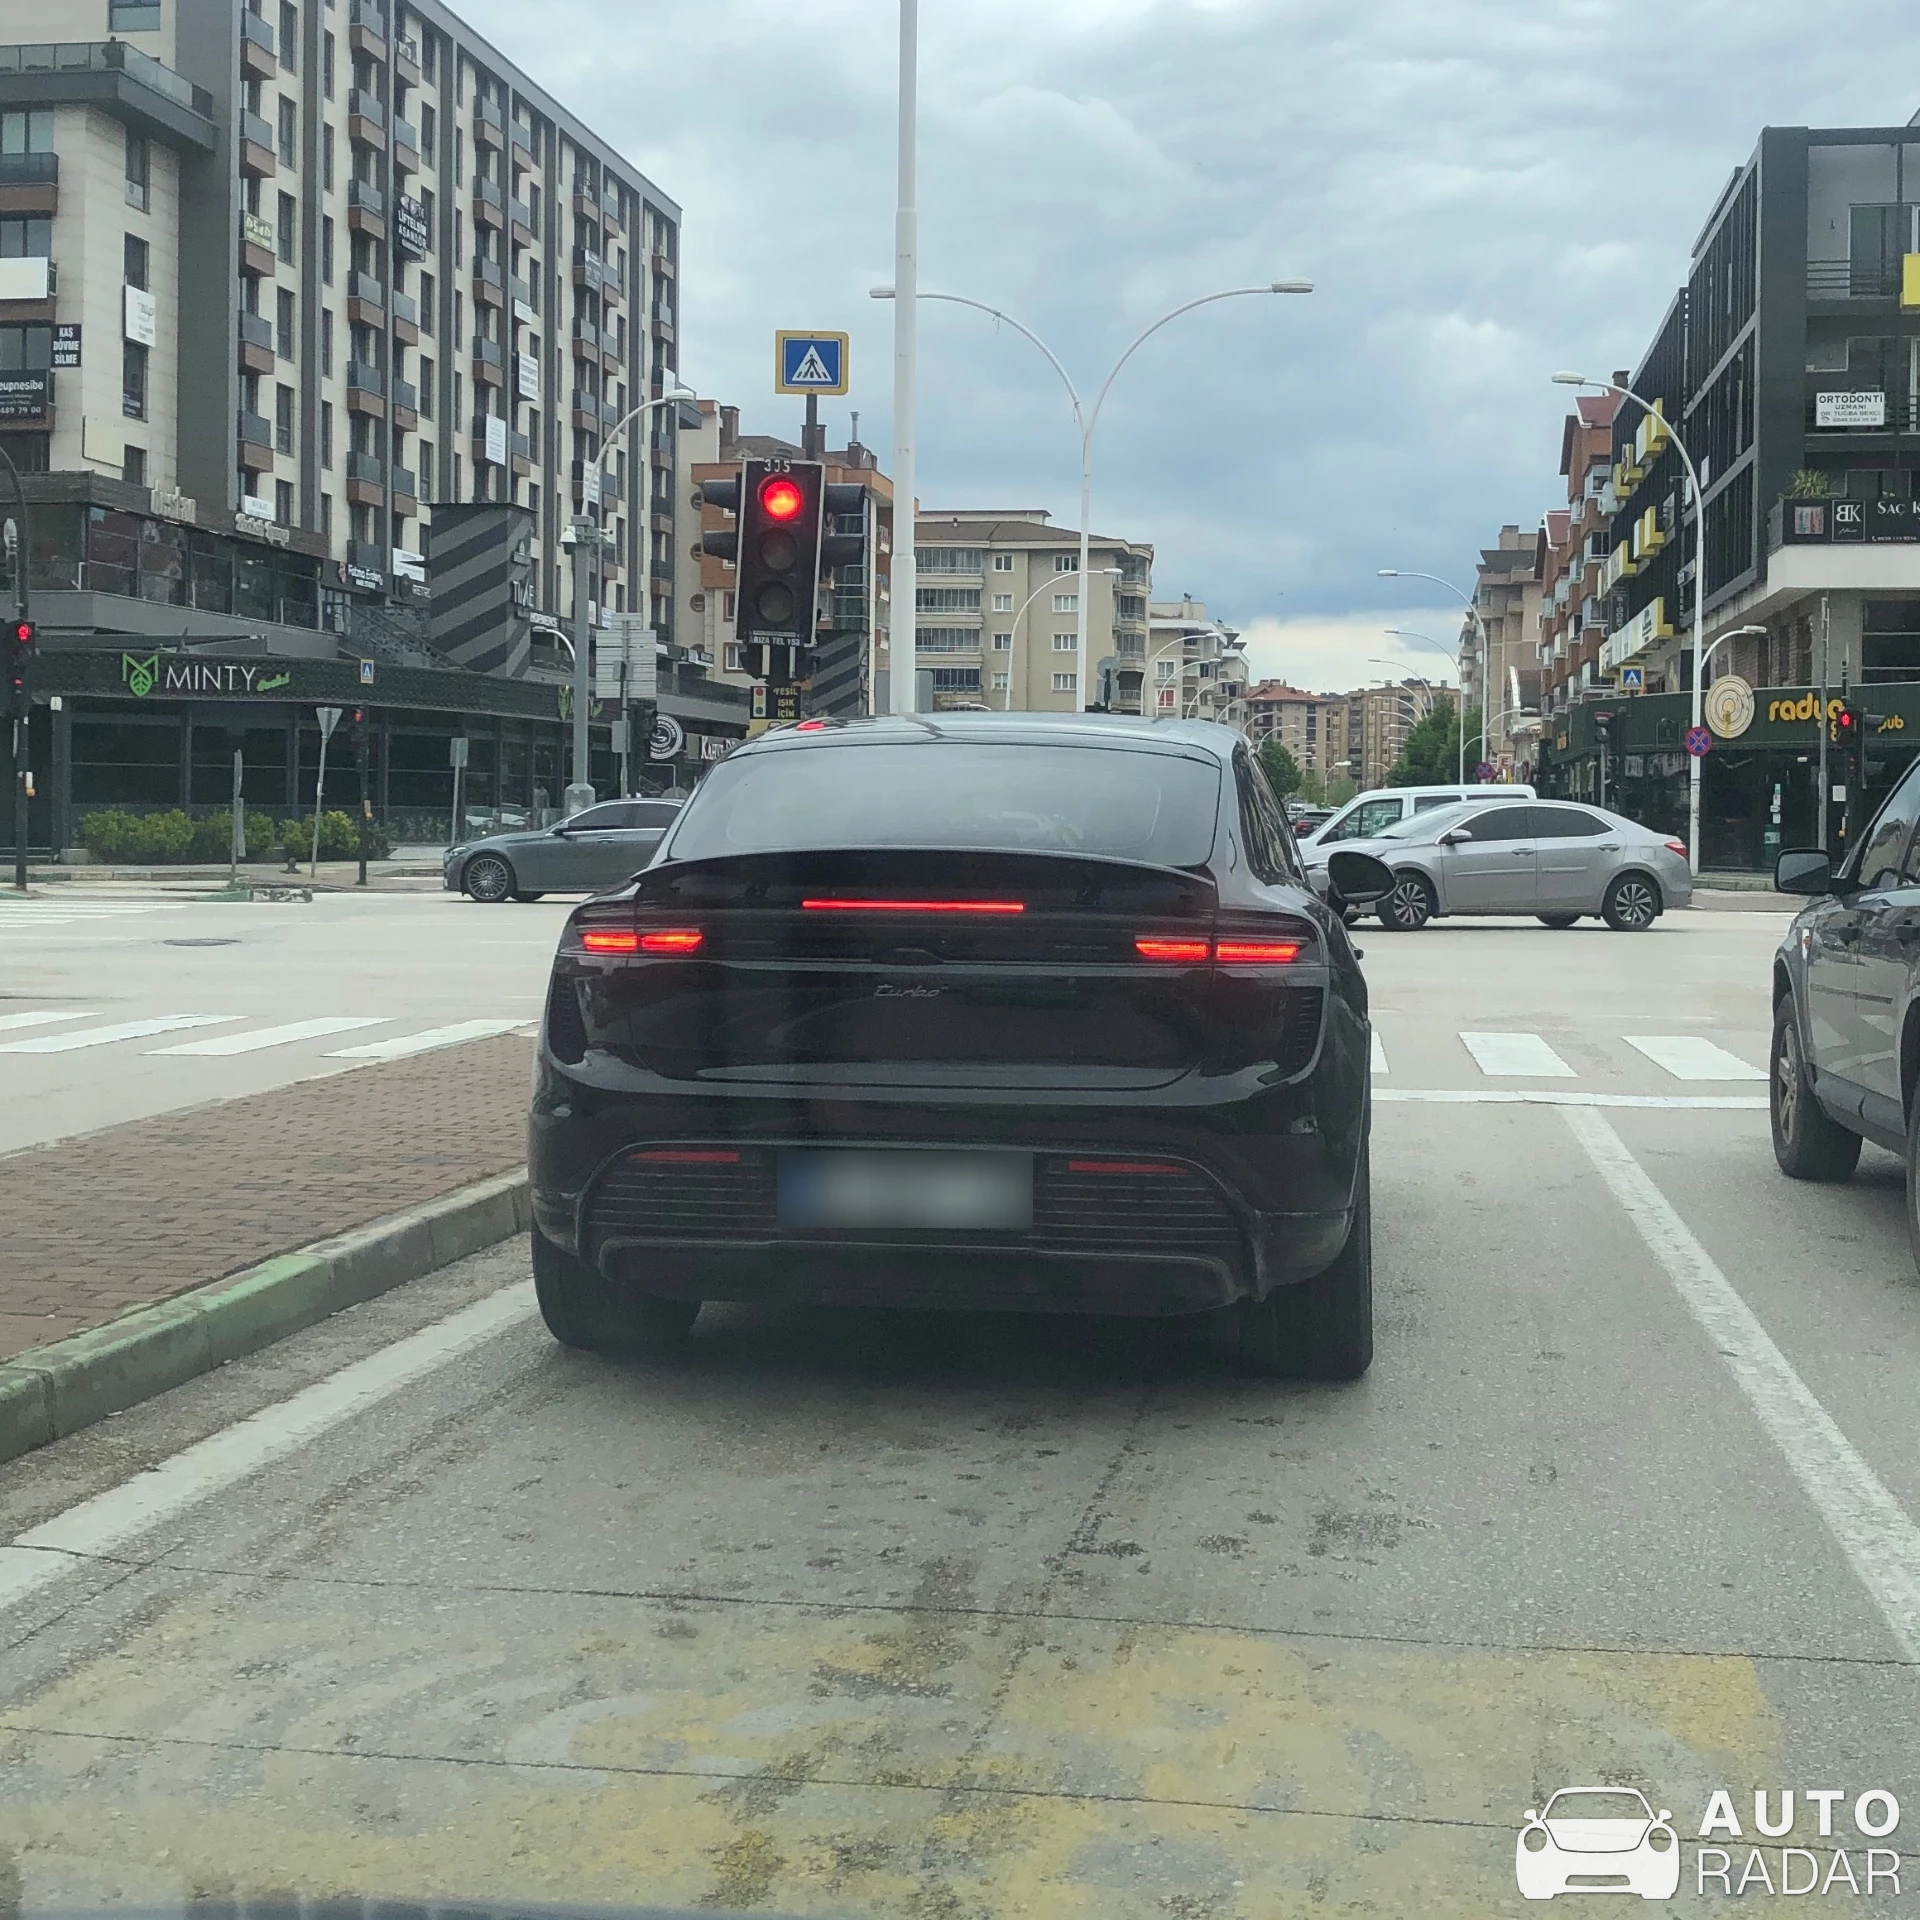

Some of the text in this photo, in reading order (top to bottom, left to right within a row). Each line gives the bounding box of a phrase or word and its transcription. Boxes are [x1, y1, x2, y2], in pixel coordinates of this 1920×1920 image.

[58, 327, 74, 338] KAŞ
[53, 338, 80, 351] DÖVME
[54, 353, 78, 364] SİLME
[1818, 394, 1883, 404] ORTODONTİ
[772, 637, 785, 645] TEL
[787, 638, 800, 646] 153
[166, 665, 257, 692] MINTY
